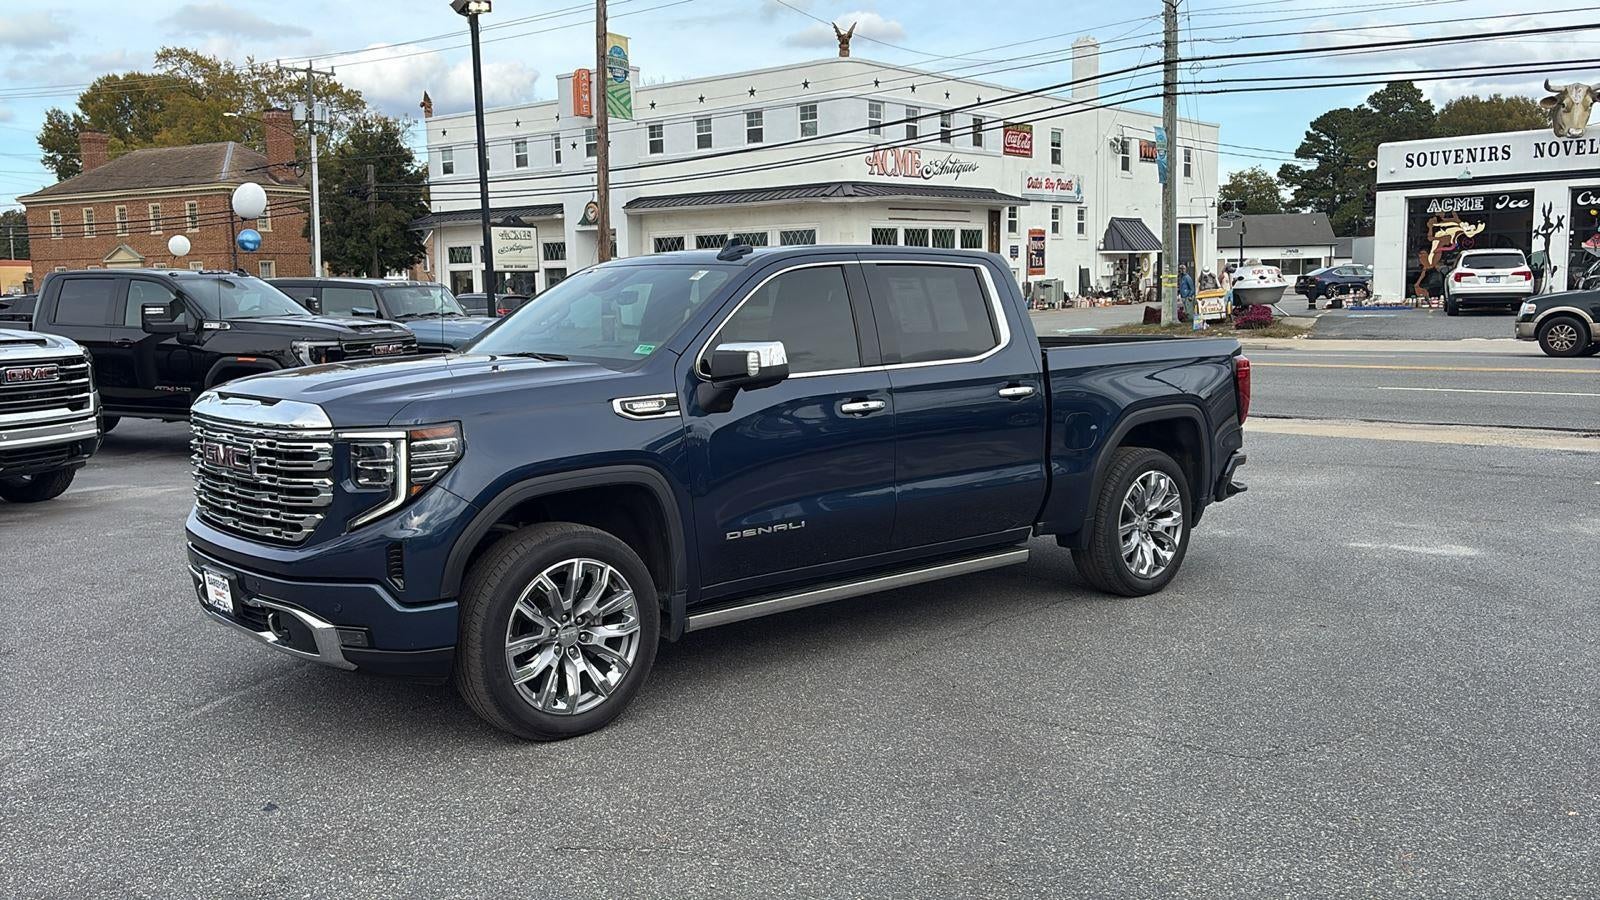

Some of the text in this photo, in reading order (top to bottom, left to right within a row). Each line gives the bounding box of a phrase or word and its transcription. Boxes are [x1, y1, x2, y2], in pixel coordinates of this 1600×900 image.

[581, 72, 589, 113] ACME
[1405, 138, 1600, 169] SOUVENIRS NOVEL
[865, 147, 921, 178] ACME
[933, 153, 979, 181] Antiques
[1044, 177, 1055, 192] Boy
[1056, 178, 1073, 191] Paints
[1427, 197, 1485, 213] ACME
[1495, 195, 1531, 210] Ice
[1031, 254, 1044, 267] TEA
[6, 367, 58, 381] GMC
[203, 442, 250, 470] GMC
[726, 520, 805, 540] DENALI
